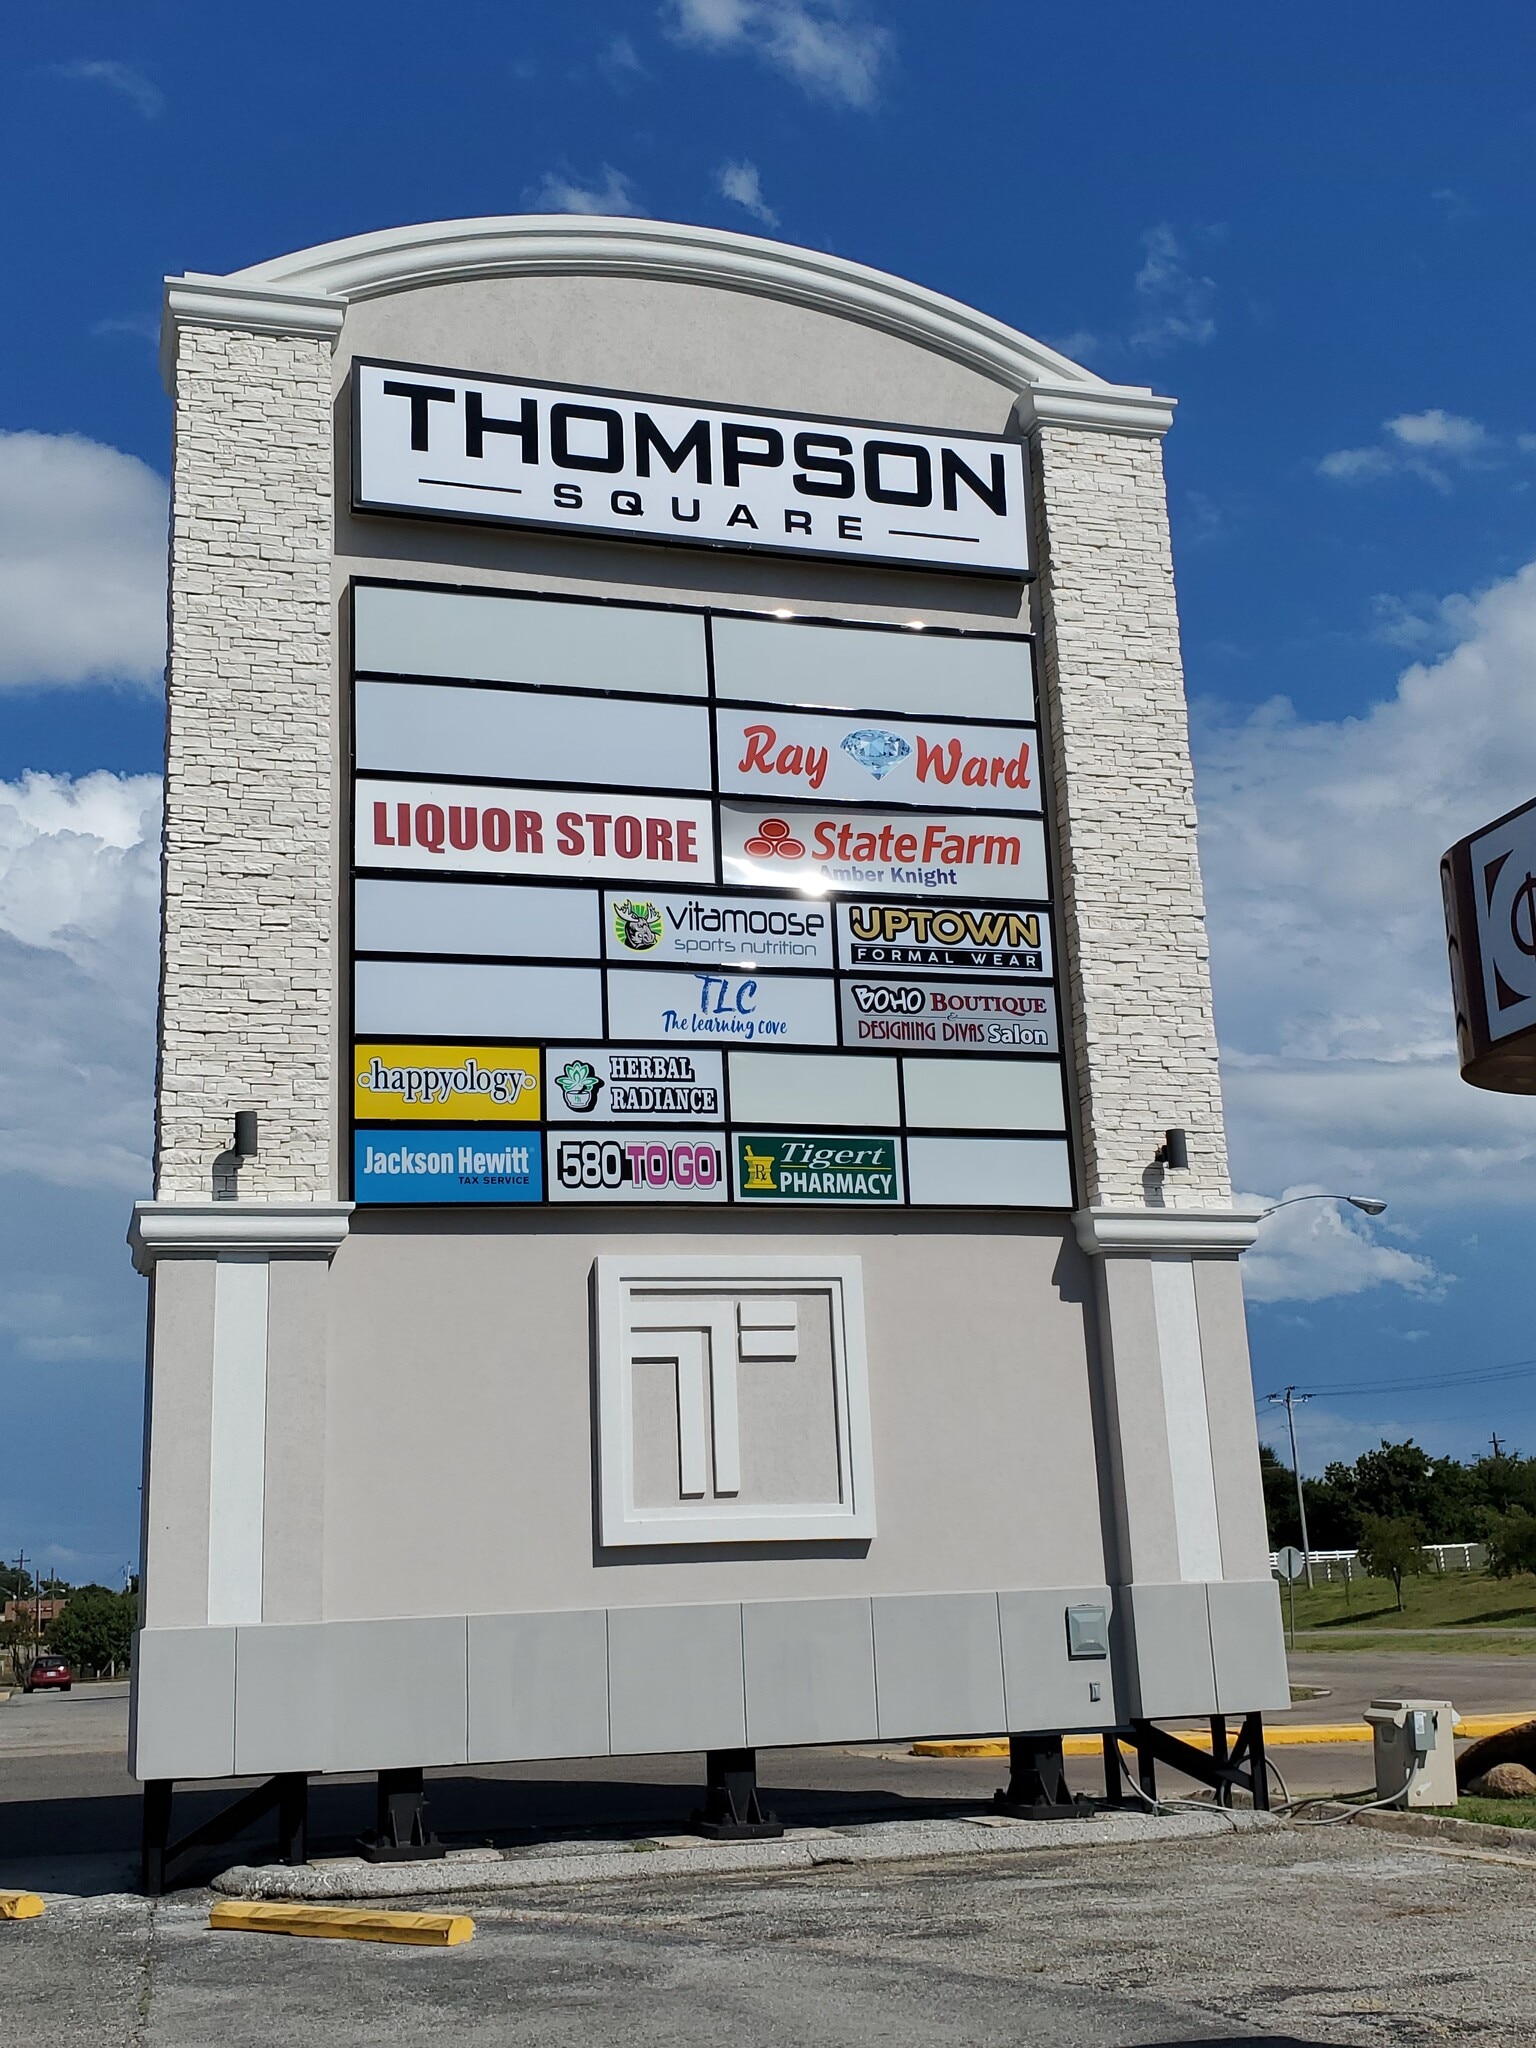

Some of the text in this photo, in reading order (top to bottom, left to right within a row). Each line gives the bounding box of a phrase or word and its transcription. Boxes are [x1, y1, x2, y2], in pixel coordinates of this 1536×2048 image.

[384, 380, 1007, 516] THOMPSON
[554, 483, 863, 540] SQUARE
[738, 725, 1031, 789] Ray Ward
[373, 801, 698, 863] LIQUOR STORE
[891, 867, 957, 888] Knight
[666, 901, 824, 937] vitamoose
[849, 906, 1041, 948] UPTOWN
[674, 937, 817, 957] sports nutrition
[857, 948, 1037, 967] FORMAL WEAR
[694, 974, 758, 1015] TLC
[851, 984, 1047, 1016] BOHO BOUTIQUE
[662, 1010, 788, 1039] The learning cove
[858, 1020, 1049, 1045] DESIGNING DIVAS Salon
[371, 1057, 523, 1103] happyology
[609, 1056, 695, 1082] HERBAL
[610, 1088, 718, 1114] RADIANCE
[363, 1146, 529, 1174] Jackson Hewitt
[560, 1140, 622, 1189] 580
[780, 1142, 886, 1169] Tigert
[458, 1176, 530, 1185] TAX SERVICE
[780, 1171, 892, 1195] PHARMACY
